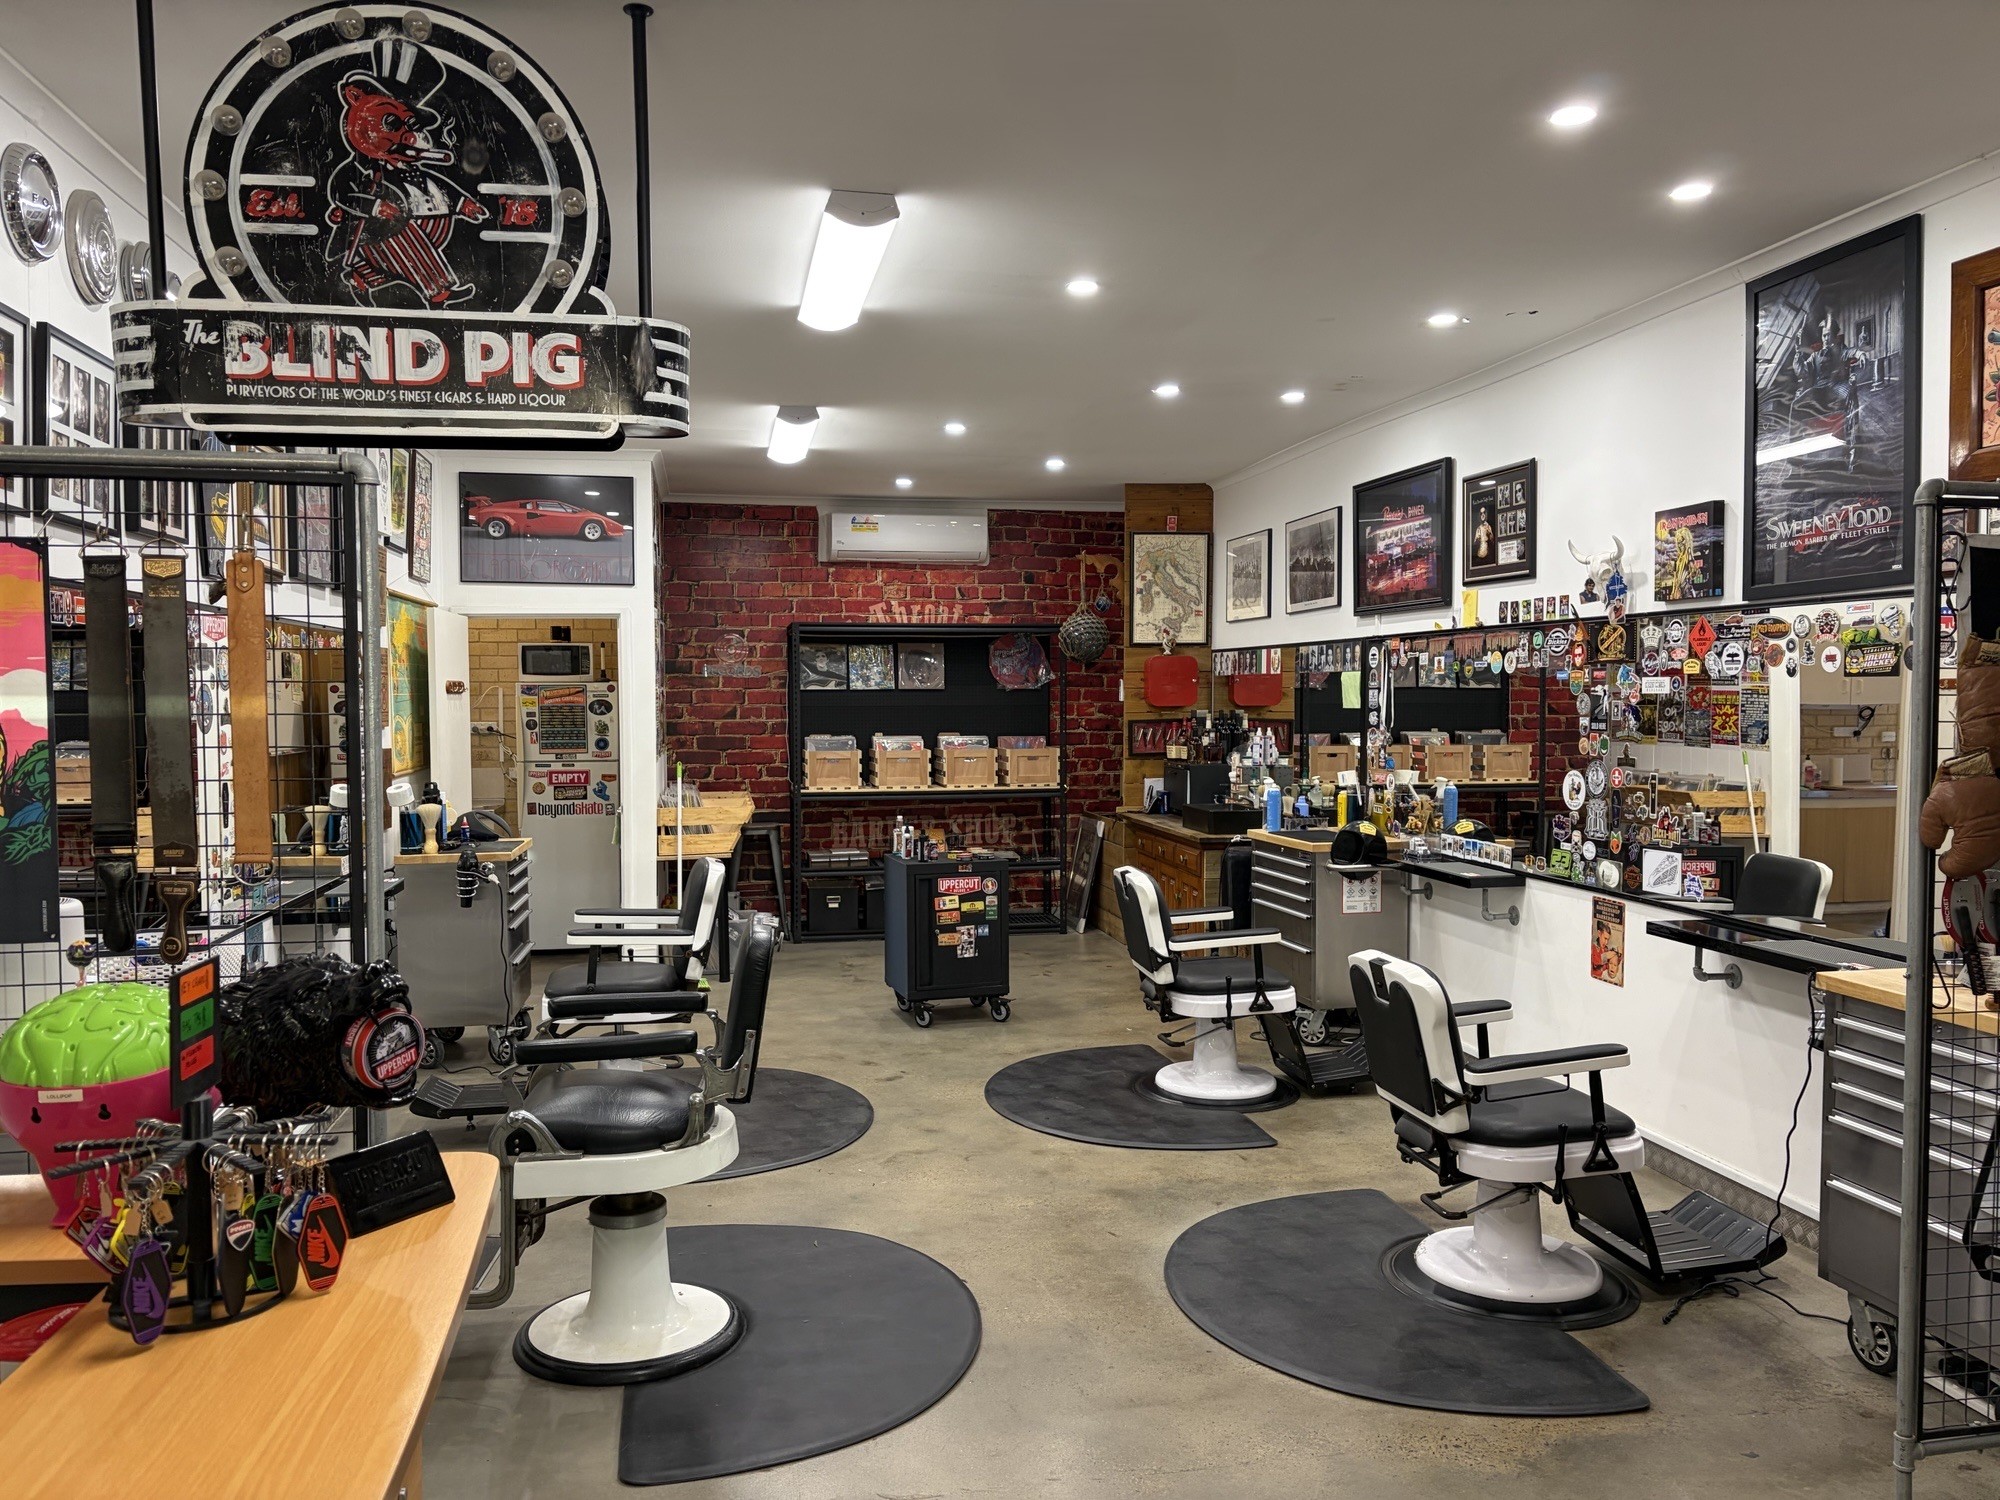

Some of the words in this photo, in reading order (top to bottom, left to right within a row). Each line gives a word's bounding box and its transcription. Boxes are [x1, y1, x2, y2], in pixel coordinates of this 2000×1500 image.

[245, 189, 306, 218] Est.
[182, 319, 221, 345] The
[222, 319, 449, 386] BLIND
[463, 330, 585, 390] PIG
[226, 384, 295, 398] PURVEYORS
[299, 386, 318, 399] OF
[321, 387, 339, 400] THE
[343, 388, 396, 402] WORLD'S
[400, 390, 431, 403] FINEST
[435, 391, 472, 404] CIGARS
[475, 392, 485, 404] &
[487, 392, 516, 405] HARD
[519, 394, 566, 407] LIQOUR
[1766, 510, 1846, 541] SWEENEY
[1840, 503, 1892, 529] TODD
[1780, 540, 1803, 548] DEMON
[1805, 535, 1828, 545] BARBER
[1841, 530, 1861, 539] FLEET
[1864, 526, 1890, 536] STREET
[1864, 652, 1894, 662] INLINE
[552, 773, 586, 783] EMPTY
[538, 802, 604, 818] beyondskate
[940, 878, 980, 891] UPPERCUT
[1942, 896, 1952, 929] CRICKET
[376, 1048, 416, 1079] UPPERCUT
[229, 1222, 252, 1234] DUCATI
[306, 1228, 326, 1263] NIKE
[131, 1276, 152, 1314] NIKE
